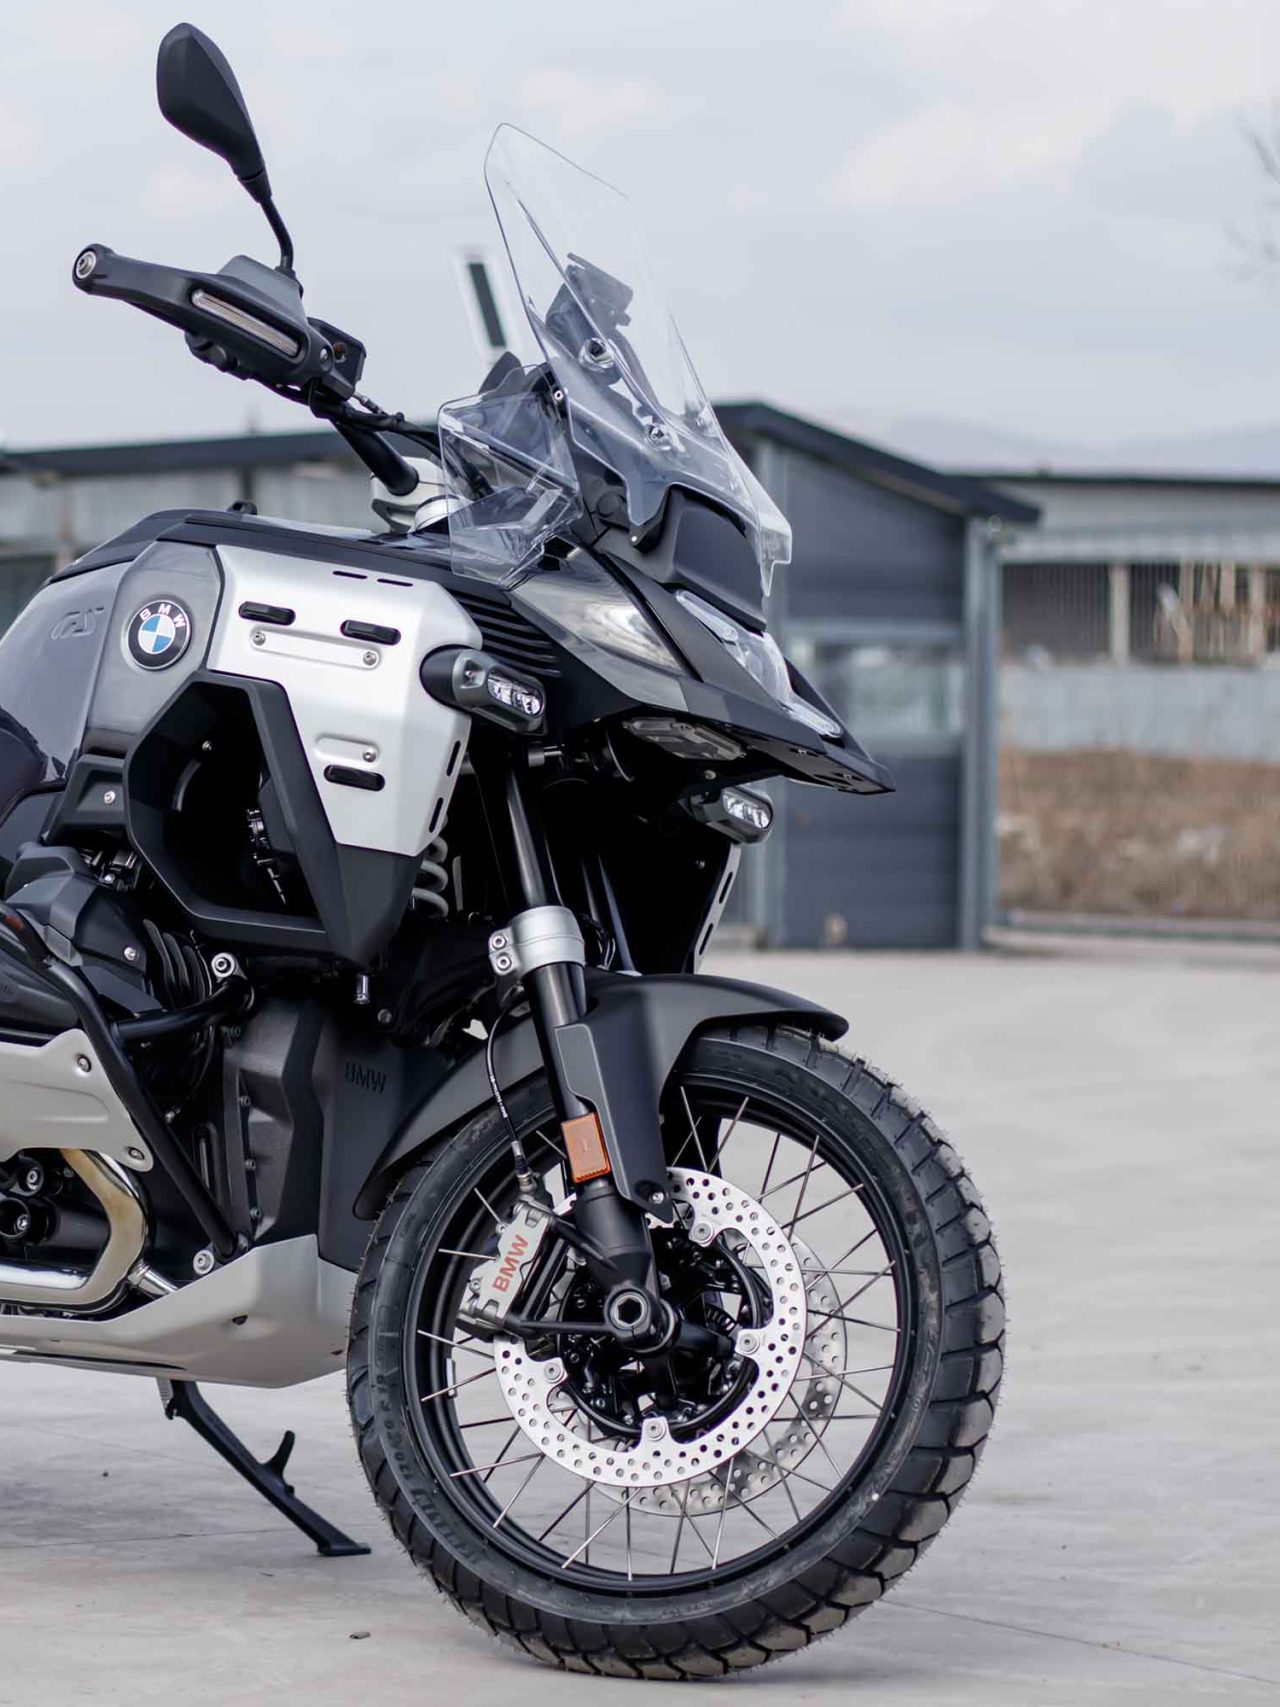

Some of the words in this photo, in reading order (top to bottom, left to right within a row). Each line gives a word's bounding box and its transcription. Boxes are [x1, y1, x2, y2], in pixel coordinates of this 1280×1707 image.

[140, 603, 186, 629] BMW
[345, 1063, 387, 1094] BMW
[492, 1234, 529, 1292] BMW
